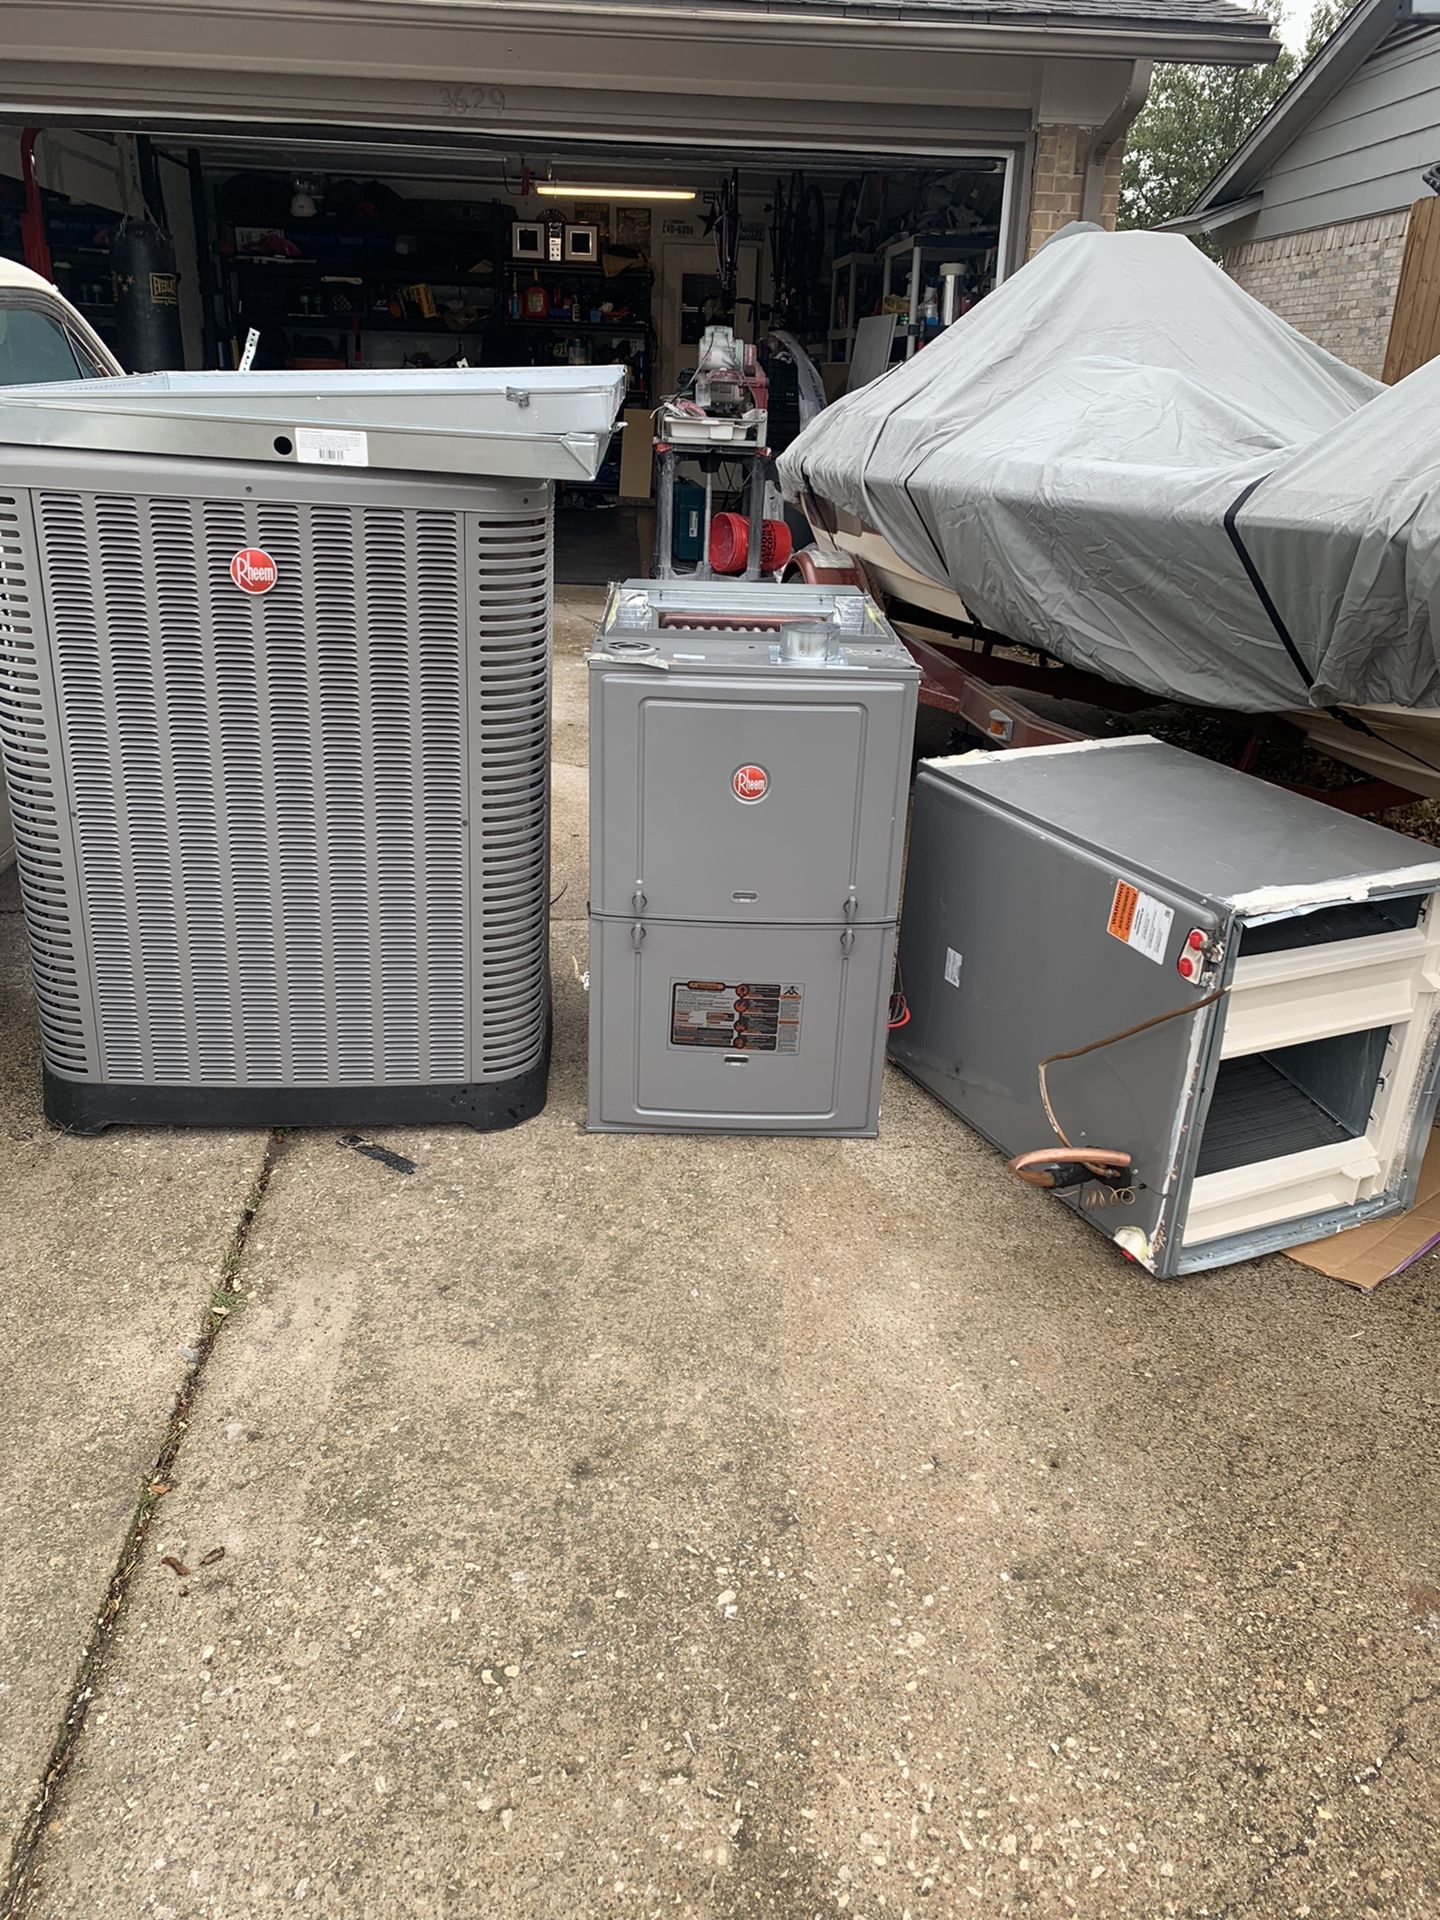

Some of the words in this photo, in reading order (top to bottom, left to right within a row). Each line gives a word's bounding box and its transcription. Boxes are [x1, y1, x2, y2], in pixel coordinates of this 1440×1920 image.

[437, 87, 505, 116] 3629
[236, 552, 274, 587] Rheem
[737, 769, 765, 794] Rheem
